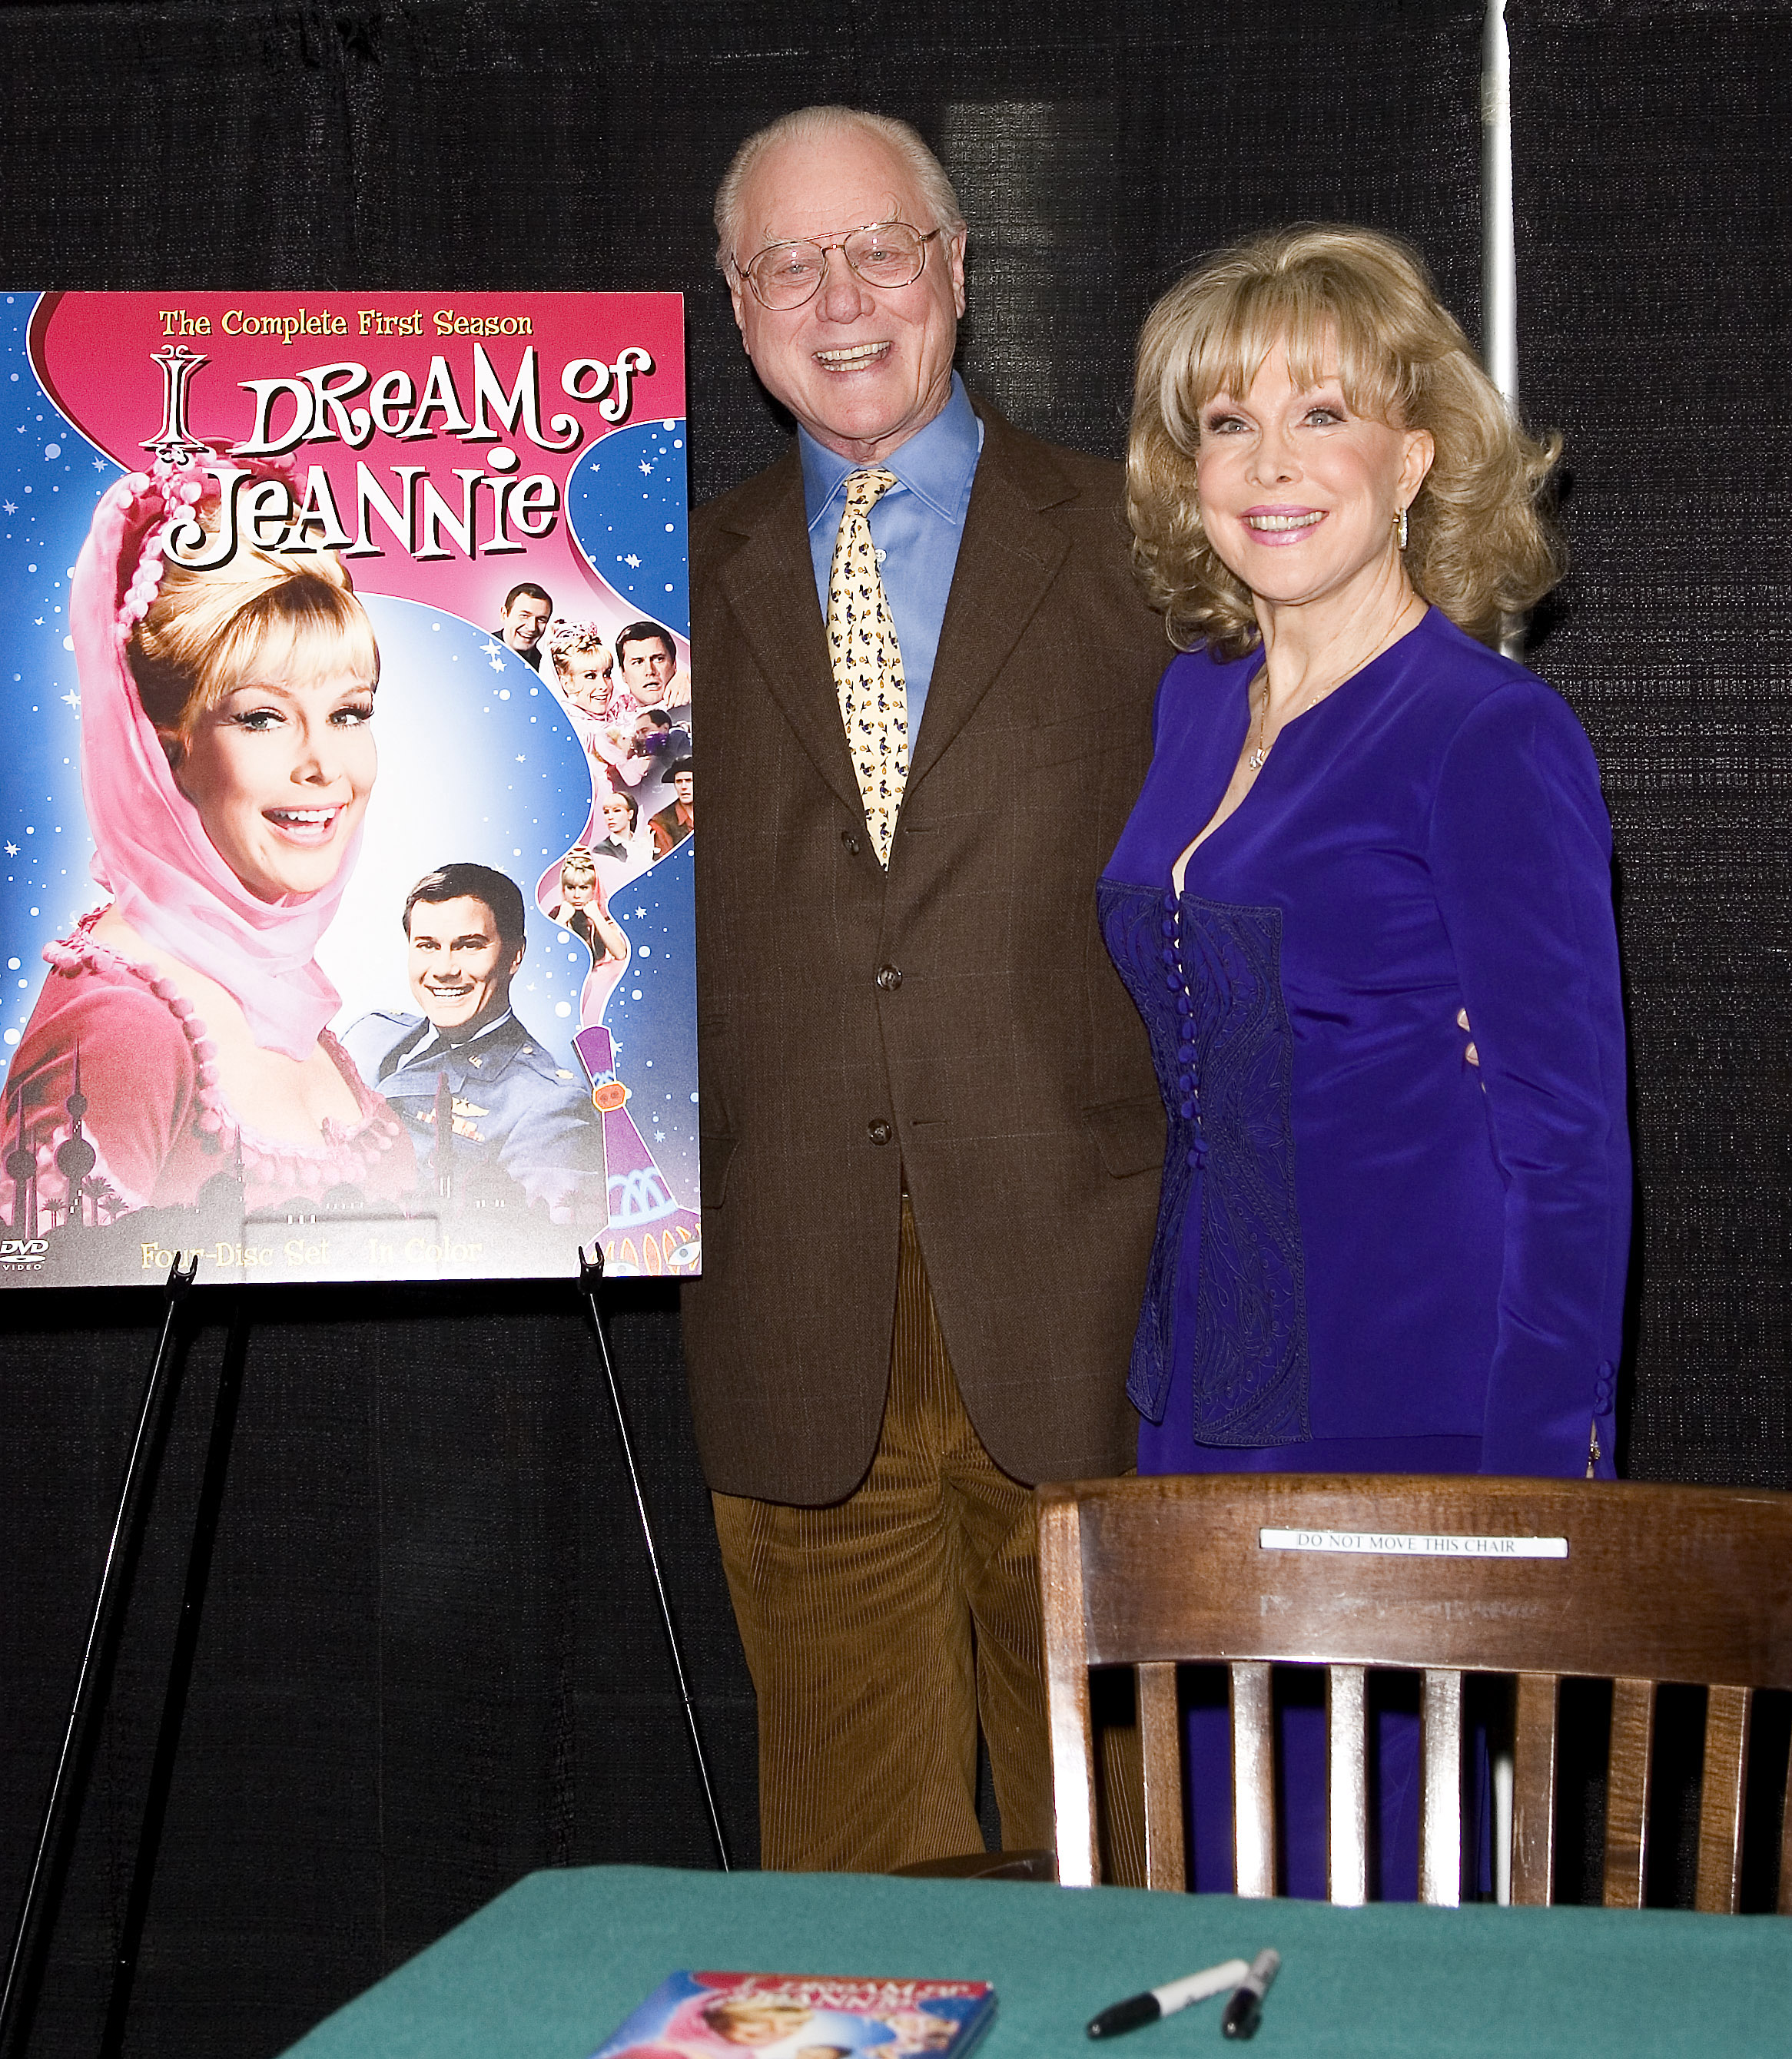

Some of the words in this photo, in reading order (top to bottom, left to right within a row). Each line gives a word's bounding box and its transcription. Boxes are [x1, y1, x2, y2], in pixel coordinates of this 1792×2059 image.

[158, 309, 211, 336] The
[221, 309, 348, 345] Complete
[357, 309, 423, 337] First
[433, 310, 534, 337] Season
[138, 344, 211, 459] I
[561, 346, 655, 425] of
[0, 1239, 49, 1255] DVD
[284, 1238, 330, 1268] Set
[368, 1238, 393, 1265] In
[404, 1235, 483, 1264] Color
[1298, 1533, 1322, 1547] DO
[1329, 1535, 1364, 1549] NOT
[1369, 1537, 1417, 1550] MOVE
[1423, 1538, 1459, 1551] THIS
[1464, 1539, 1515, 1553] CHAIR
